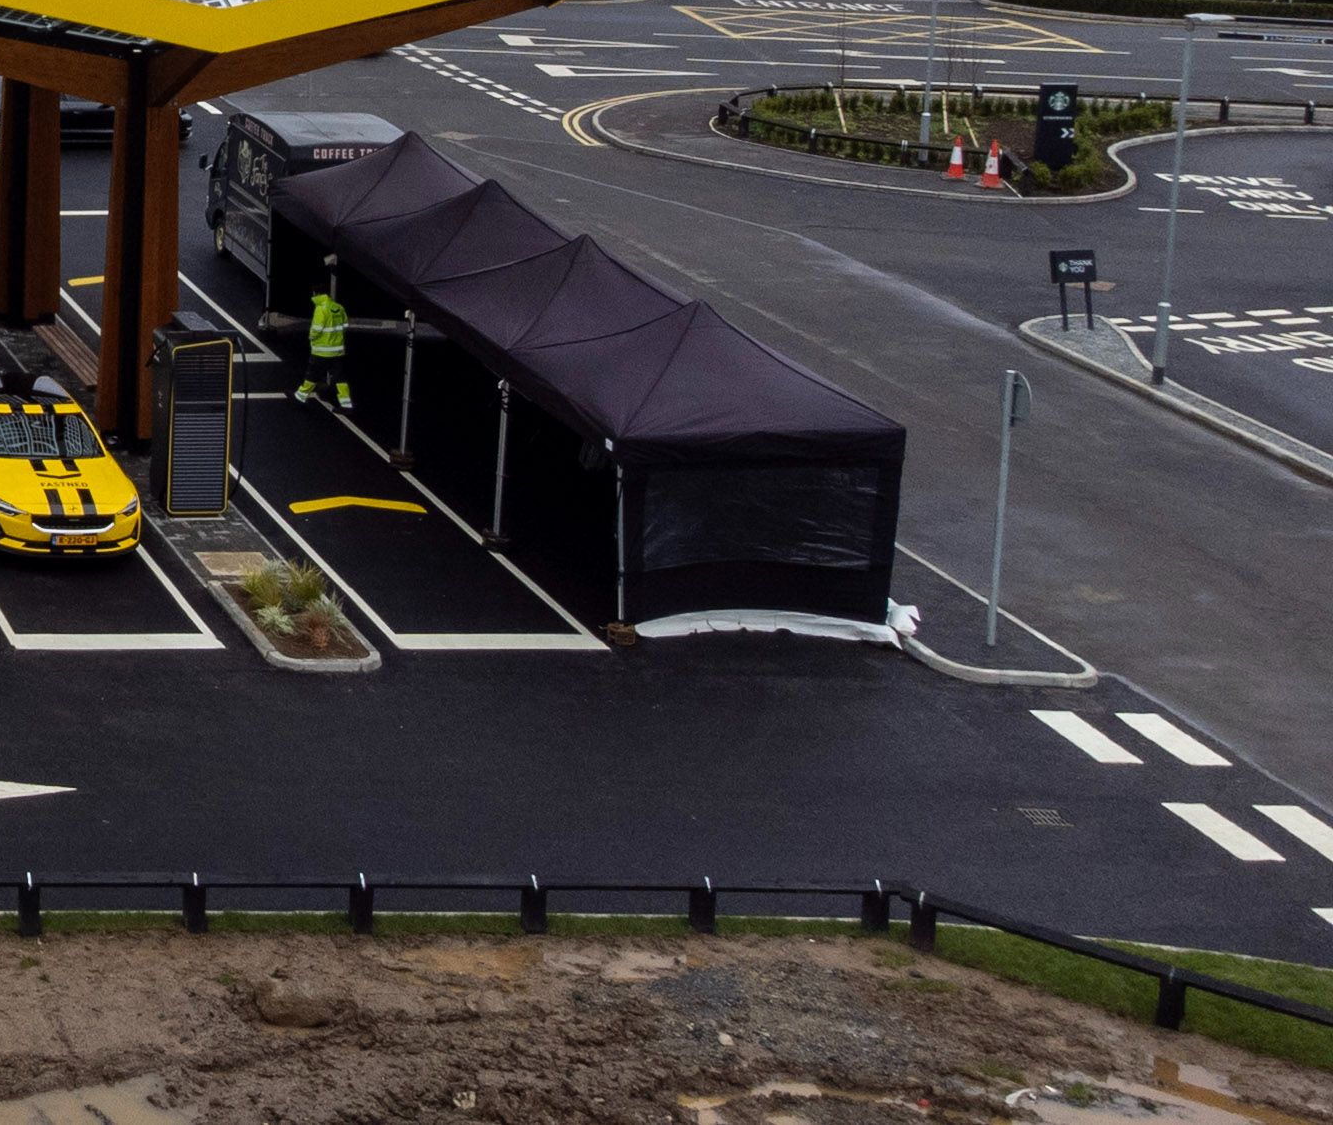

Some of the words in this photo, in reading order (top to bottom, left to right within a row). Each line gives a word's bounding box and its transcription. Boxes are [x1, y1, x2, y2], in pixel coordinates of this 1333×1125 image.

[313, 148, 354, 160] COFFEE
[1154, 173, 1297, 188] DRIVE
[1195, 186, 1314, 201] THRU
